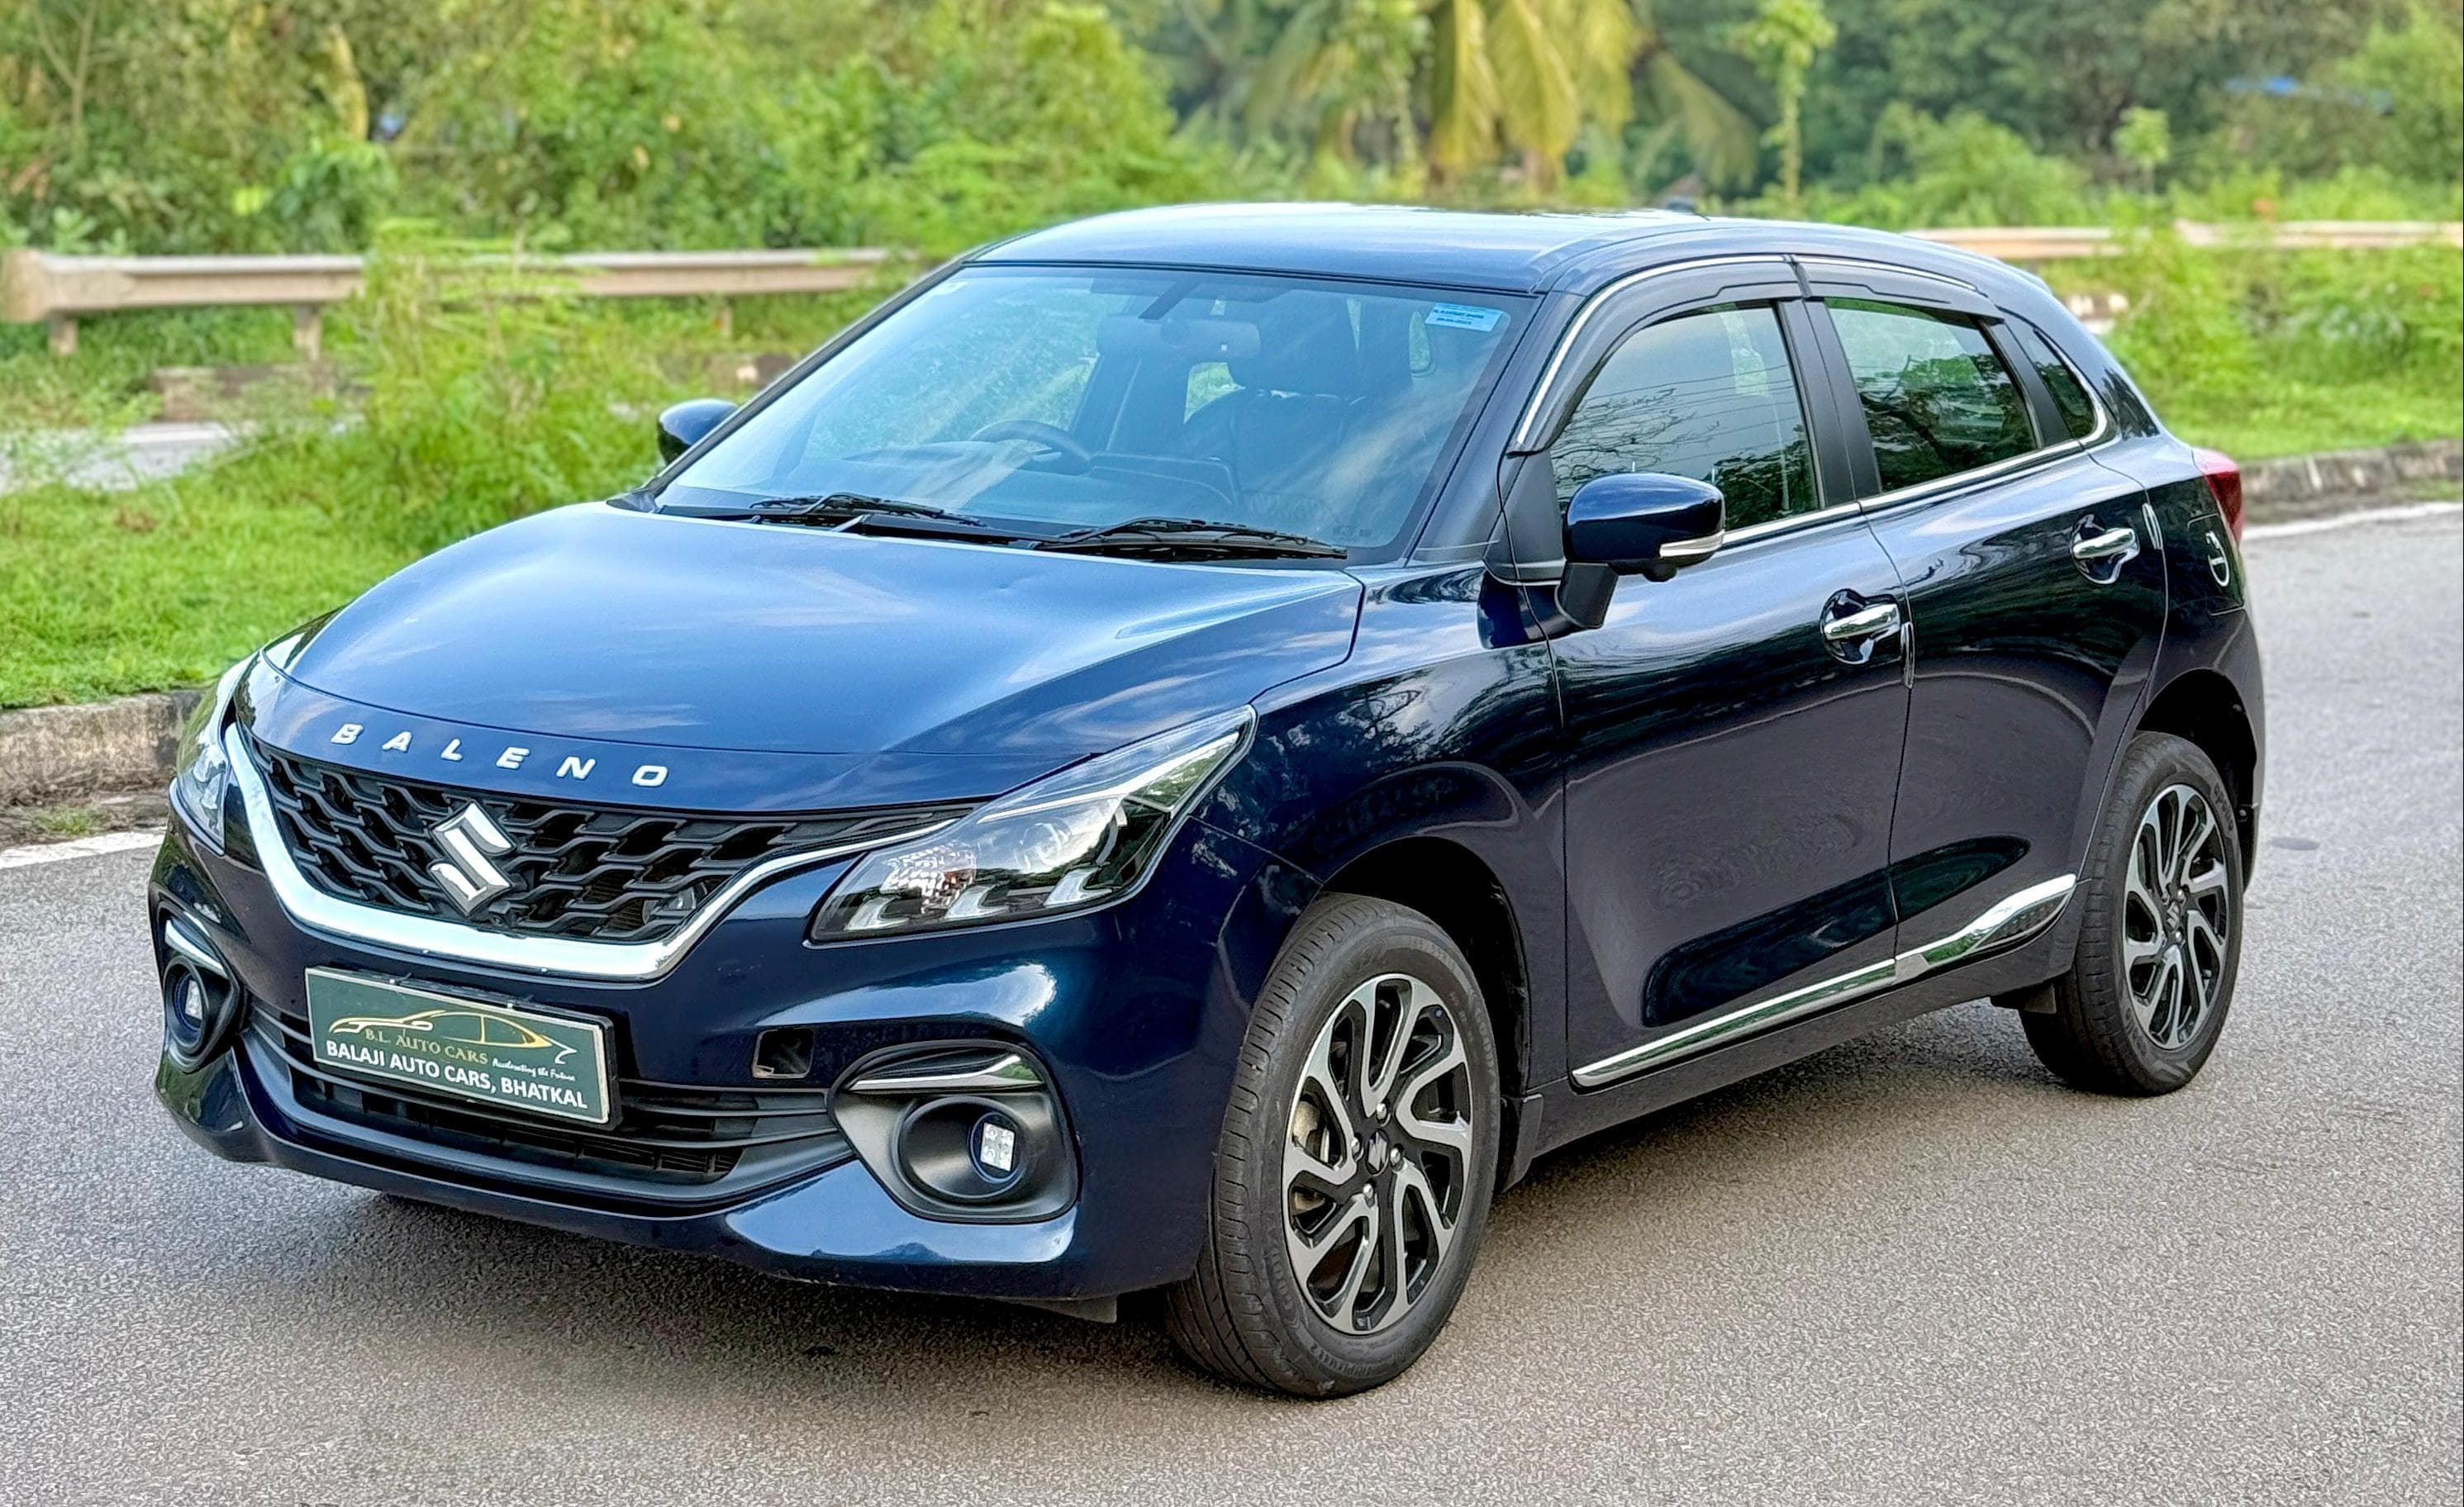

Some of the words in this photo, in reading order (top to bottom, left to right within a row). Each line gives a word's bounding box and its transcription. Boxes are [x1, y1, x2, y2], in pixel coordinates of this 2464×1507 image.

[330, 723, 669, 787] BALENO
[326, 1039, 385, 1067] BALAJI
[389, 1053, 440, 1078] AUTO
[444, 1065, 497, 1094] CARS,
[501, 1077, 588, 1109] BHATKAL
[365, 1028, 391, 1043] B.L.
[395, 1032, 441, 1055] AUTO
[444, 1043, 489, 1065] CARS
